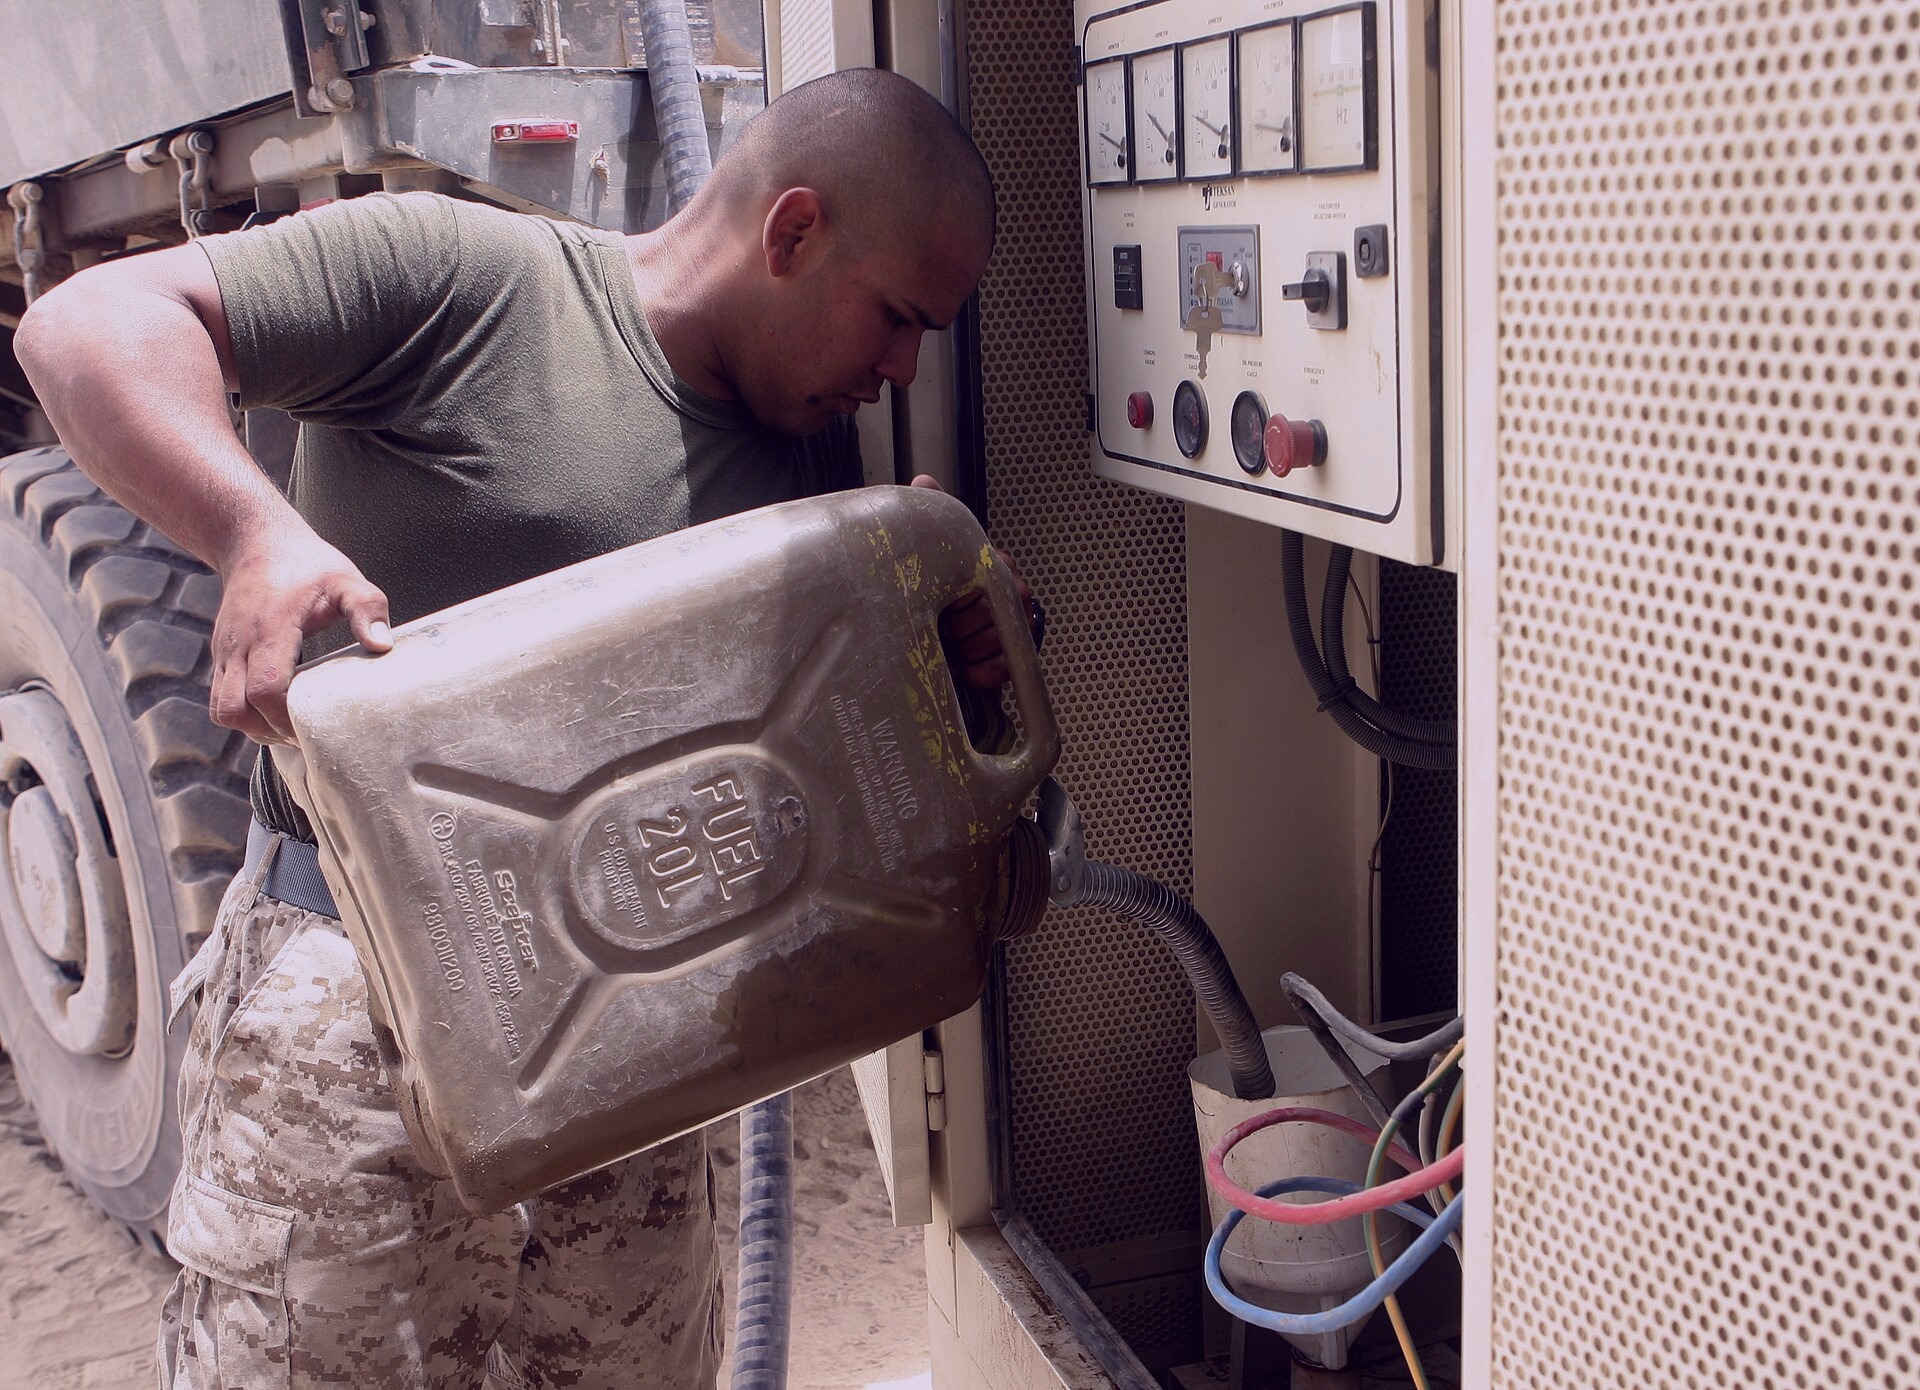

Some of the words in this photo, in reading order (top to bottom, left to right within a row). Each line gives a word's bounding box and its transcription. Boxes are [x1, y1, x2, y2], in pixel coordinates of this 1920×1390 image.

[868, 717, 921, 822] WARNING
[634, 806, 706, 909] 20L
[690, 772, 765, 901] FUEL
[597, 849, 628, 914] PROPERTY
[610, 845, 649, 930] GOVERNMENT
[486, 924, 507, 945] AU
[493, 942, 525, 999] CANADA
